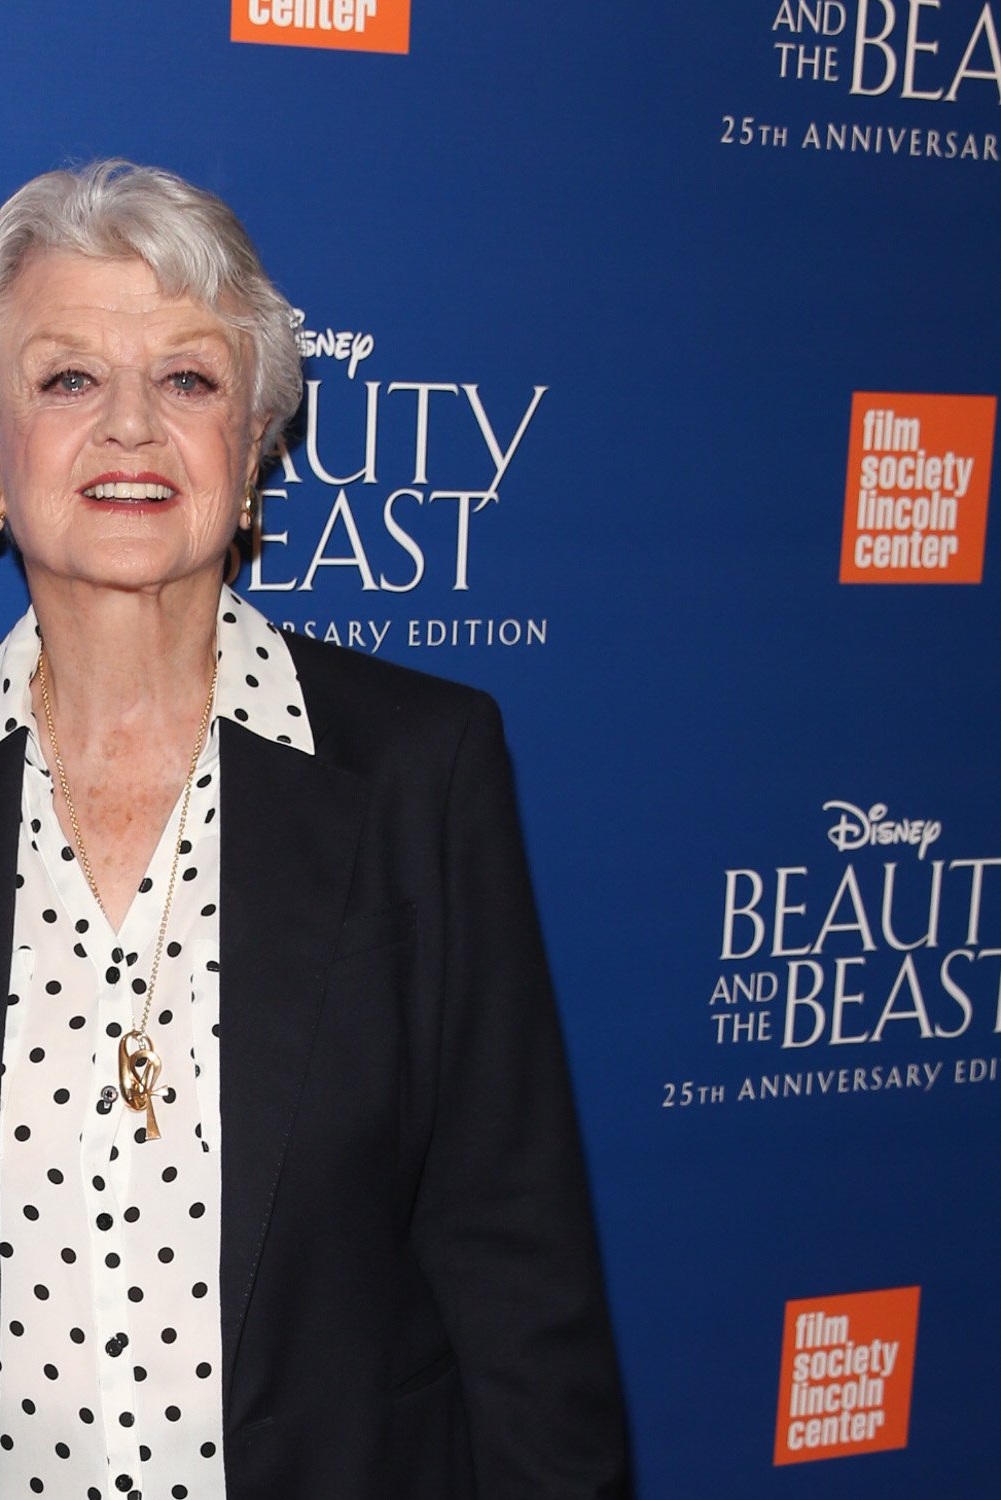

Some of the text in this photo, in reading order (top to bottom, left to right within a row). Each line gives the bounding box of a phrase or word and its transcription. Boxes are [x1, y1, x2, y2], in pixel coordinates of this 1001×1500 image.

[248, 0, 377, 33] center
[772, 0, 847, 36] AND
[773, 42, 840, 82] THE
[721, 115, 788, 147] 25TH
[862, 408, 920, 451] film
[860, 449, 975, 497] society
[856, 489, 959, 531] lincoln
[248, 487, 500, 593] EAST
[854, 530, 959, 569] center
[407, 618, 548, 647] EDITION
[708, 971, 779, 1006] AND
[711, 1010, 772, 1045] THE
[661, 1080, 725, 1108] 25TH
[737, 1061, 943, 1102] ANNIVERSARY
[795, 1311, 849, 1349] film
[792, 1338, 899, 1382] society
[789, 1373, 885, 1418] lincoln
[787, 1409, 886, 1451] center
